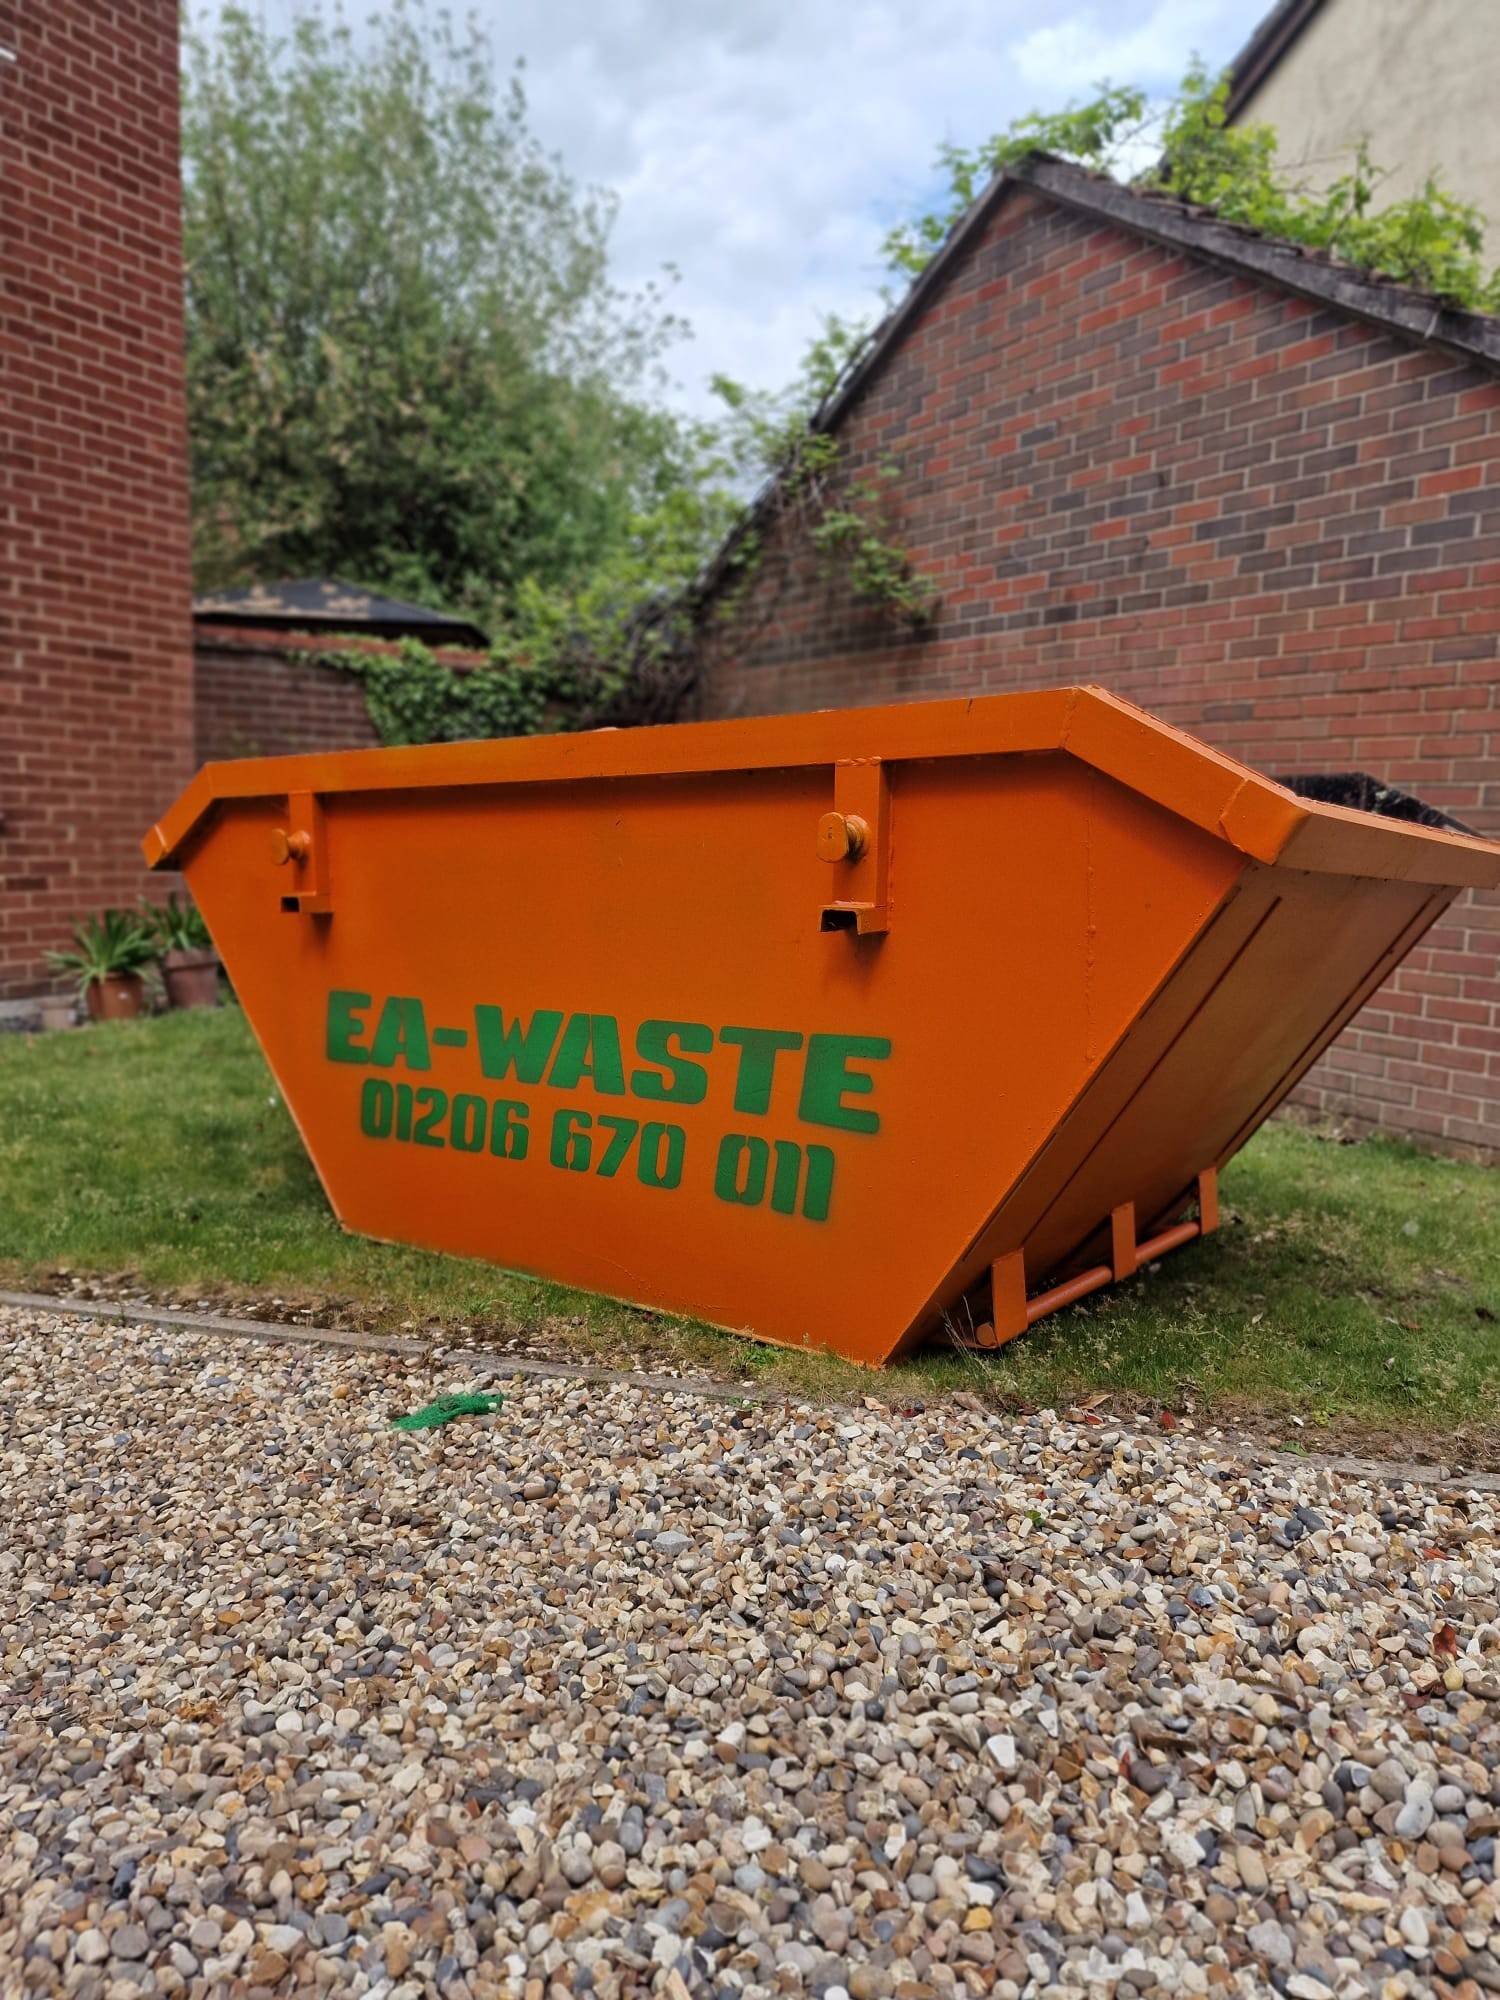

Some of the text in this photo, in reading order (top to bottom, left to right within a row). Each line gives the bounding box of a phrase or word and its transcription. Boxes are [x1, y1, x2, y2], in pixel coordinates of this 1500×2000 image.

[326, 990, 892, 1134] EA-WASTE
[360, 1078, 836, 1222] 01206 670 011
